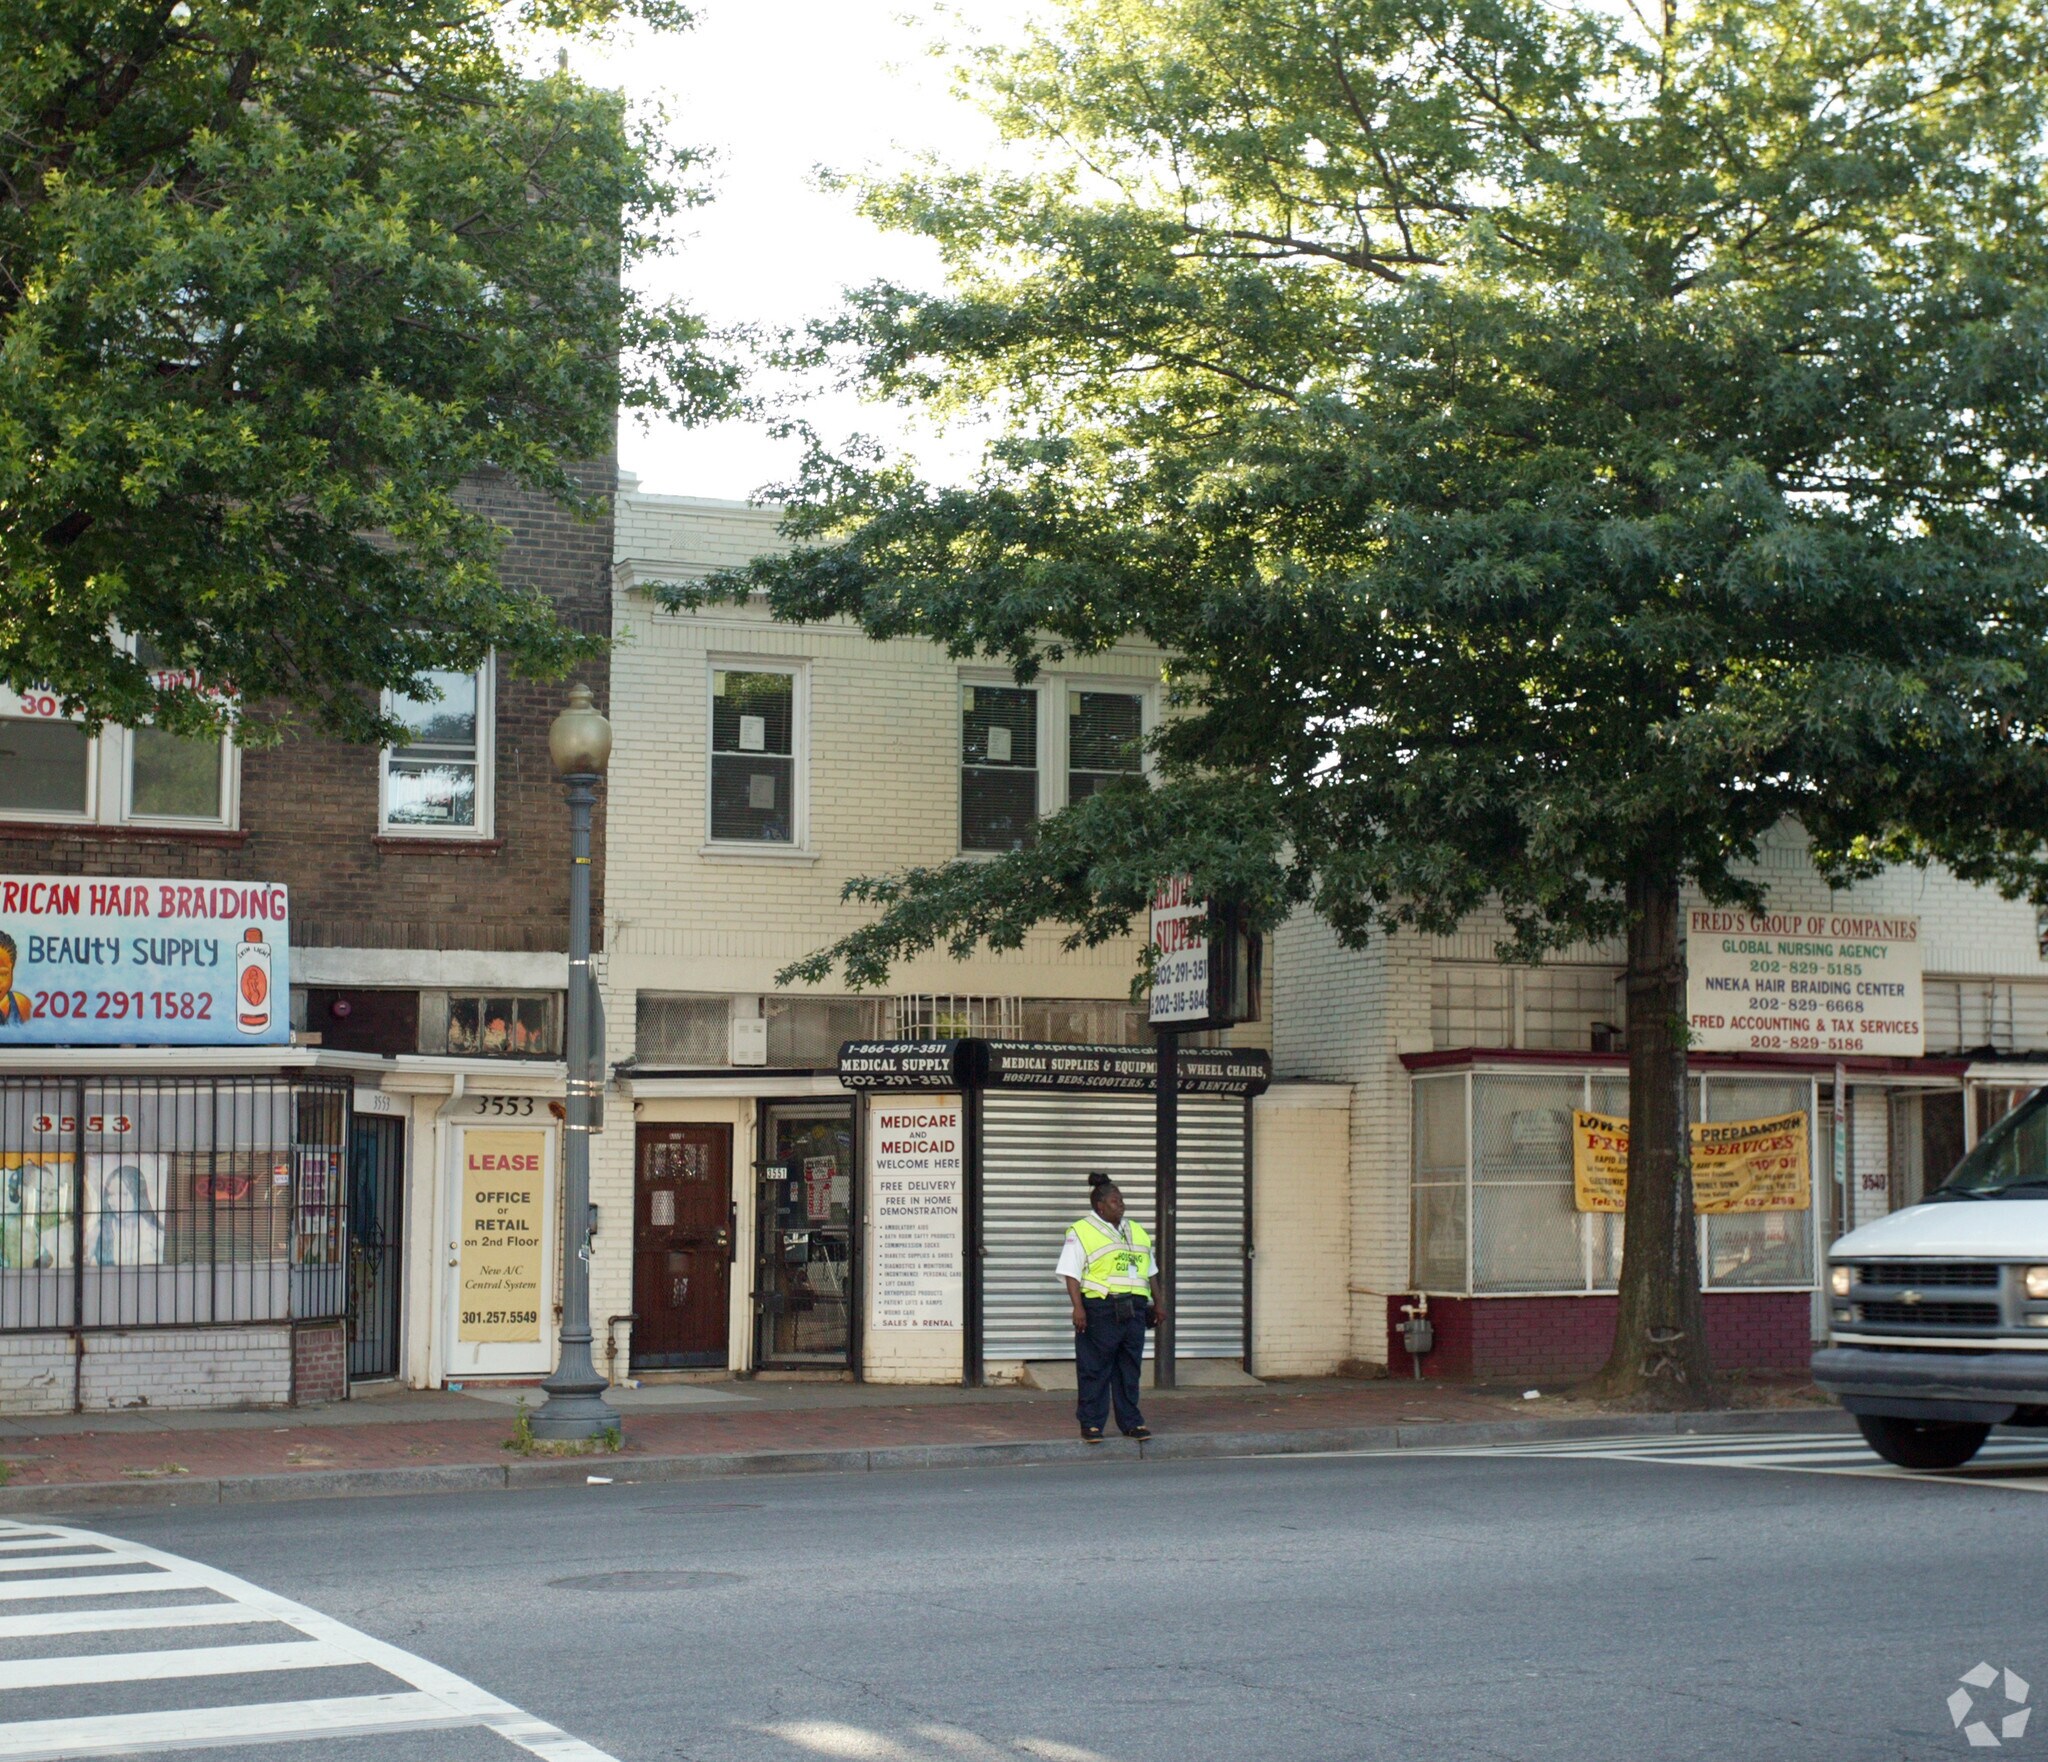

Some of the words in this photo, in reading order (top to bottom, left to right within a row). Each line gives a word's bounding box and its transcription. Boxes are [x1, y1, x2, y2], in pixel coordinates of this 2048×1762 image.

[0, 881, 80, 916] RICAN
[89, 884, 150, 917] HAIR
[158, 886, 286, 921] BRAIDING
[1692, 912, 1745, 931] FRED'S
[1751, 915, 1801, 934] GROUP
[1807, 916, 1825, 935] OF
[1831, 917, 1917, 939] COMPANIES
[132, 937, 218, 967] SUPPLY
[1722, 940, 1772, 954] GLOBAL
[1778, 942, 1835, 957] NURSING
[1839, 945, 1888, 959] AGENCY
[1750, 960, 1862, 976] 202-829-5185
[1706, 977, 1750, 992] NNEKA
[1756, 979, 1785, 993] HAIR
[1792, 980, 1851, 995] BRAIDING
[1856, 982, 1905, 997] CENTER
[32, 991, 87, 1018] 202
[95, 991, 144, 1019] 291
[151, 992, 213, 1020] 1582
[1749, 998, 1864, 1013] 202-829-6668
[1692, 1015, 1725, 1029] FRED
[1730, 1016, 1810, 1032] ACCOUNTING
[1816, 1019, 1825, 1031] &
[1831, 1019, 1854, 1033] TAX
[1860, 1020, 1919, 1034] SERVICES
[848, 1044, 946, 1054] 1-866-691-3511
[1750, 1036, 1864, 1050] 202-829-5186
[841, 1058, 897, 1071] MEDICAL
[902, 1058, 950, 1071] SUPPLY
[1002, 1057, 1047, 1070] MEDICAL
[1051, 1058, 1100, 1071] SUPPLIES
[1103, 1060, 1111, 1072] &
[1187, 1063, 1223, 1076] WHEEL
[1227, 1065, 1266, 1079] CHAIRS,
[841, 1075, 954, 1085] 202-291-3511
[1003, 1073, 1053, 1083] HOSPITAL
[1197, 1081, 1248, 1091] RENTALS
[474, 1095, 534, 1116] 3553
[881, 1115, 956, 1129] MEDICARE
[909, 1131, 927, 1139] AND
[881, 1140, 955, 1154] MEDICAID
[1704, 1135, 1794, 1156] SERVICES
[469, 1154, 539, 1171] LEASE
[877, 1159, 929, 1169] WELCOME
[935, 1159, 960, 1168] HERE
[881, 1182, 902, 1191] FREE
[908, 1181, 956, 1190] DELIVERY
[475, 1191, 530, 1203] OFFICE
[886, 1196, 906, 1205] FREE
[911, 1196, 919, 1204] IN
[925, 1196, 952, 1204] HOME
[497, 1207, 508, 1215] or
[880, 1206, 958, 1216] DEMONSTRATION
[475, 1219, 529, 1231] RETAIL
[464, 1239, 477, 1247] on
[482, 1237, 503, 1246] 2nd
[507, 1236, 539, 1247] Floor
[479, 1265, 501, 1276] New
[504, 1265, 523, 1276] A/C
[465, 1279, 502, 1290] Central
[504, 1279, 536, 1292] System
[462, 1311, 537, 1324] 301.257.5549
